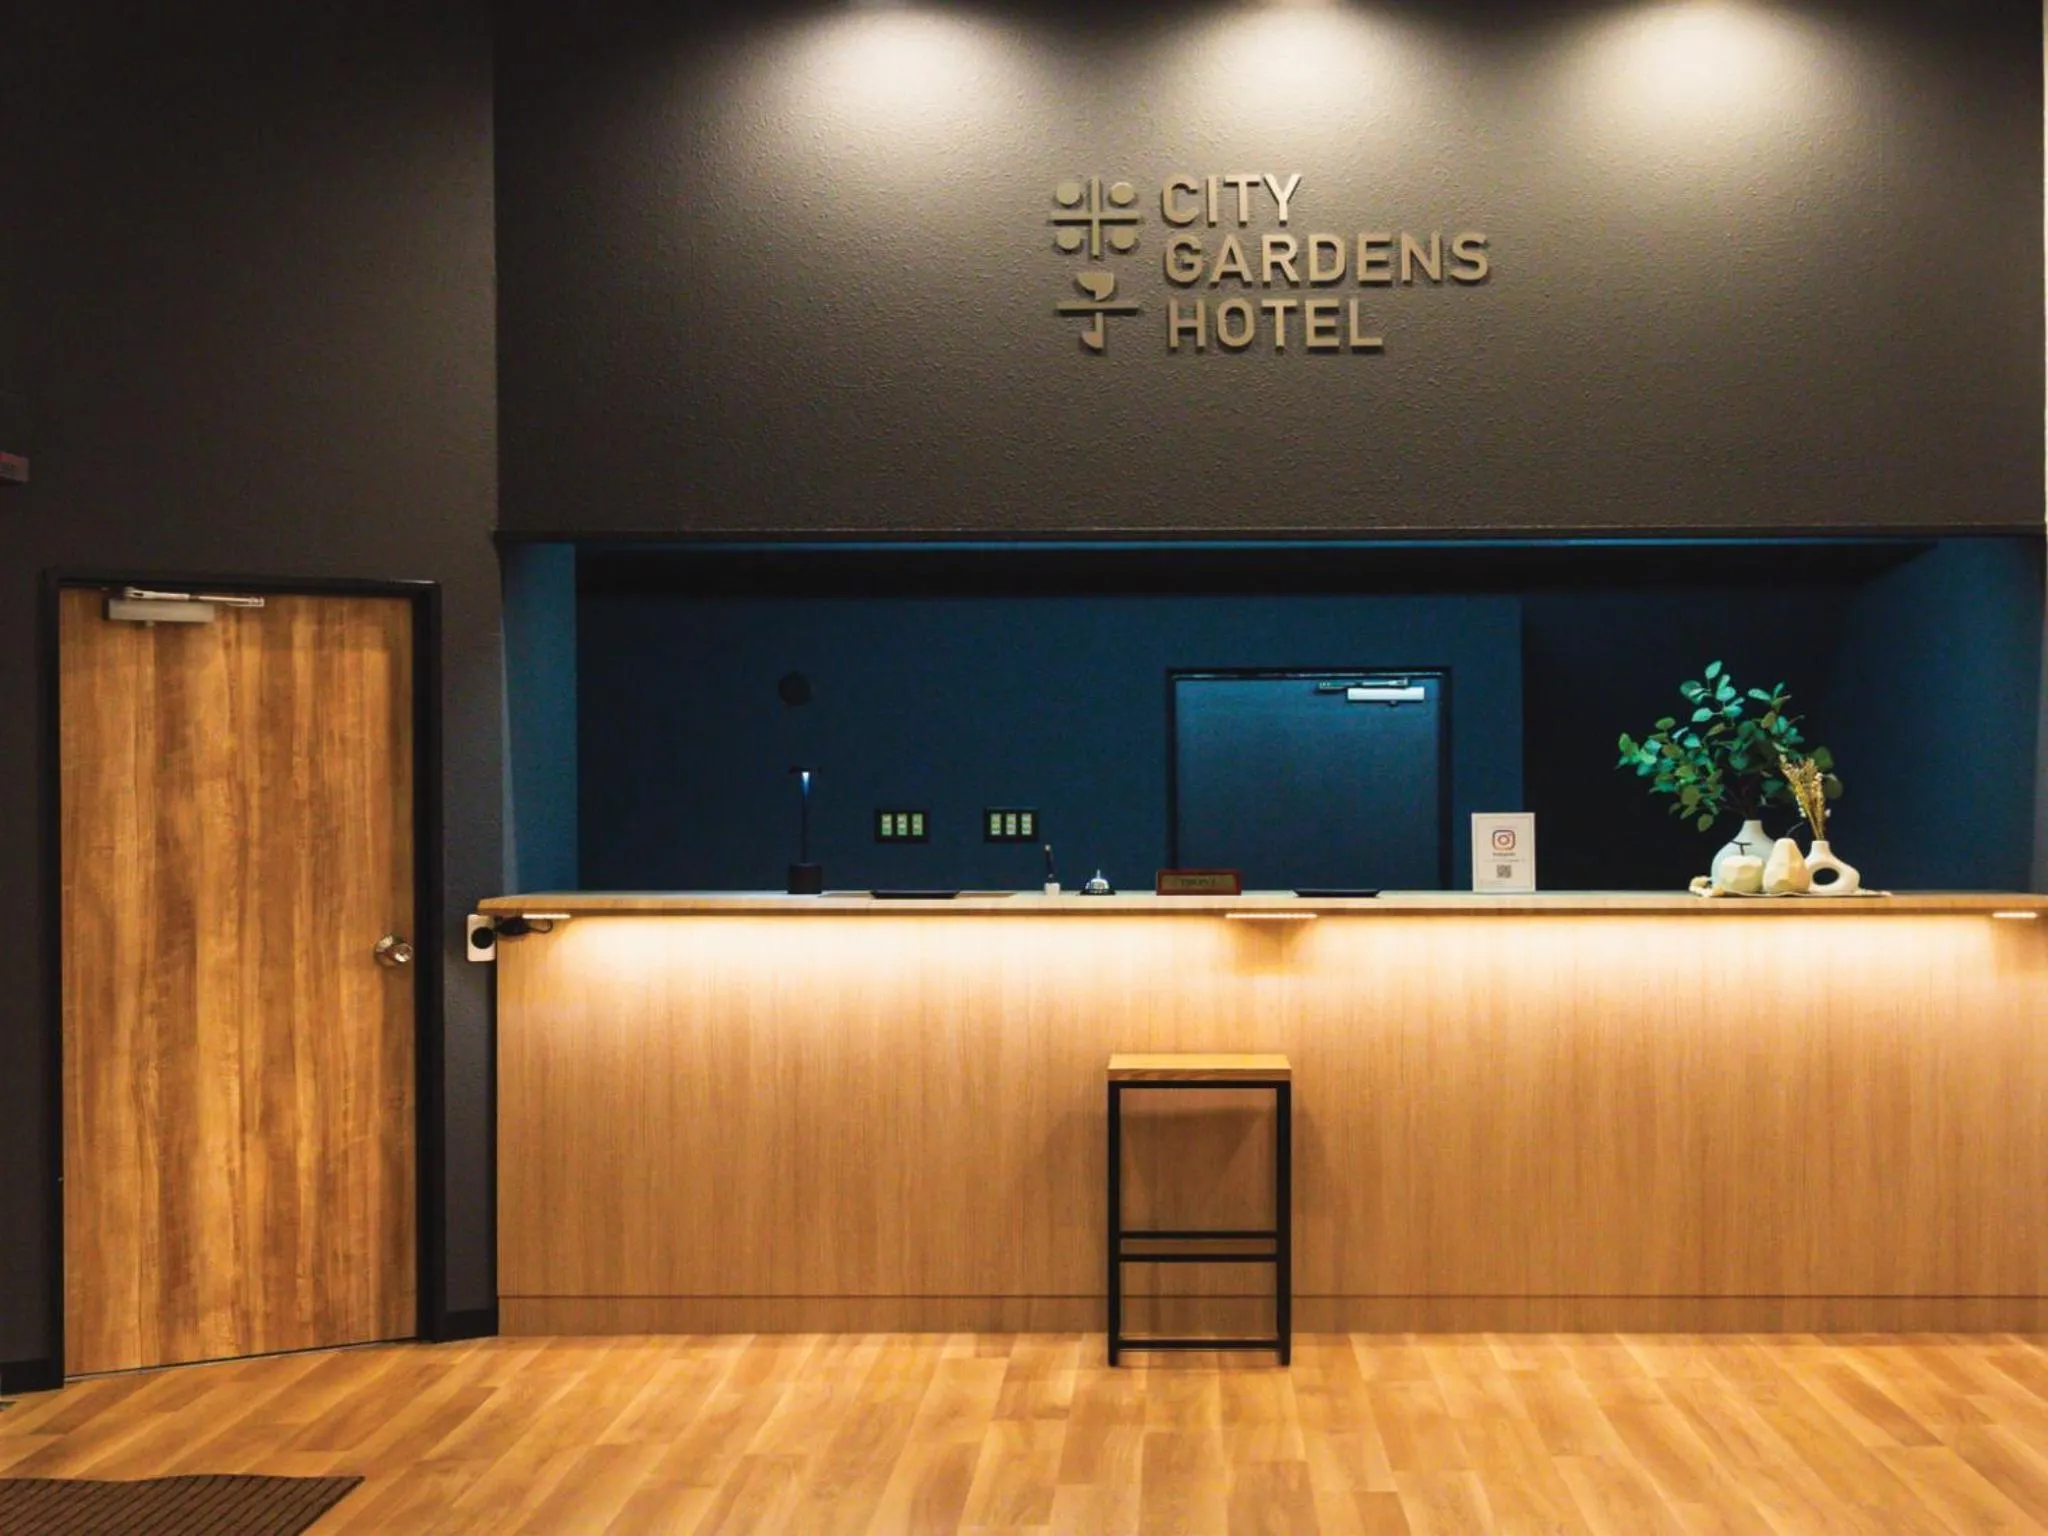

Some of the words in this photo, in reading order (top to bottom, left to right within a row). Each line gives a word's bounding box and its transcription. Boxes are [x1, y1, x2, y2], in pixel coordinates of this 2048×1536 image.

[1162, 173, 1302, 226] CITY
[1165, 231, 1490, 287] GARDENS
[1168, 297, 1384, 353] HOTEL
